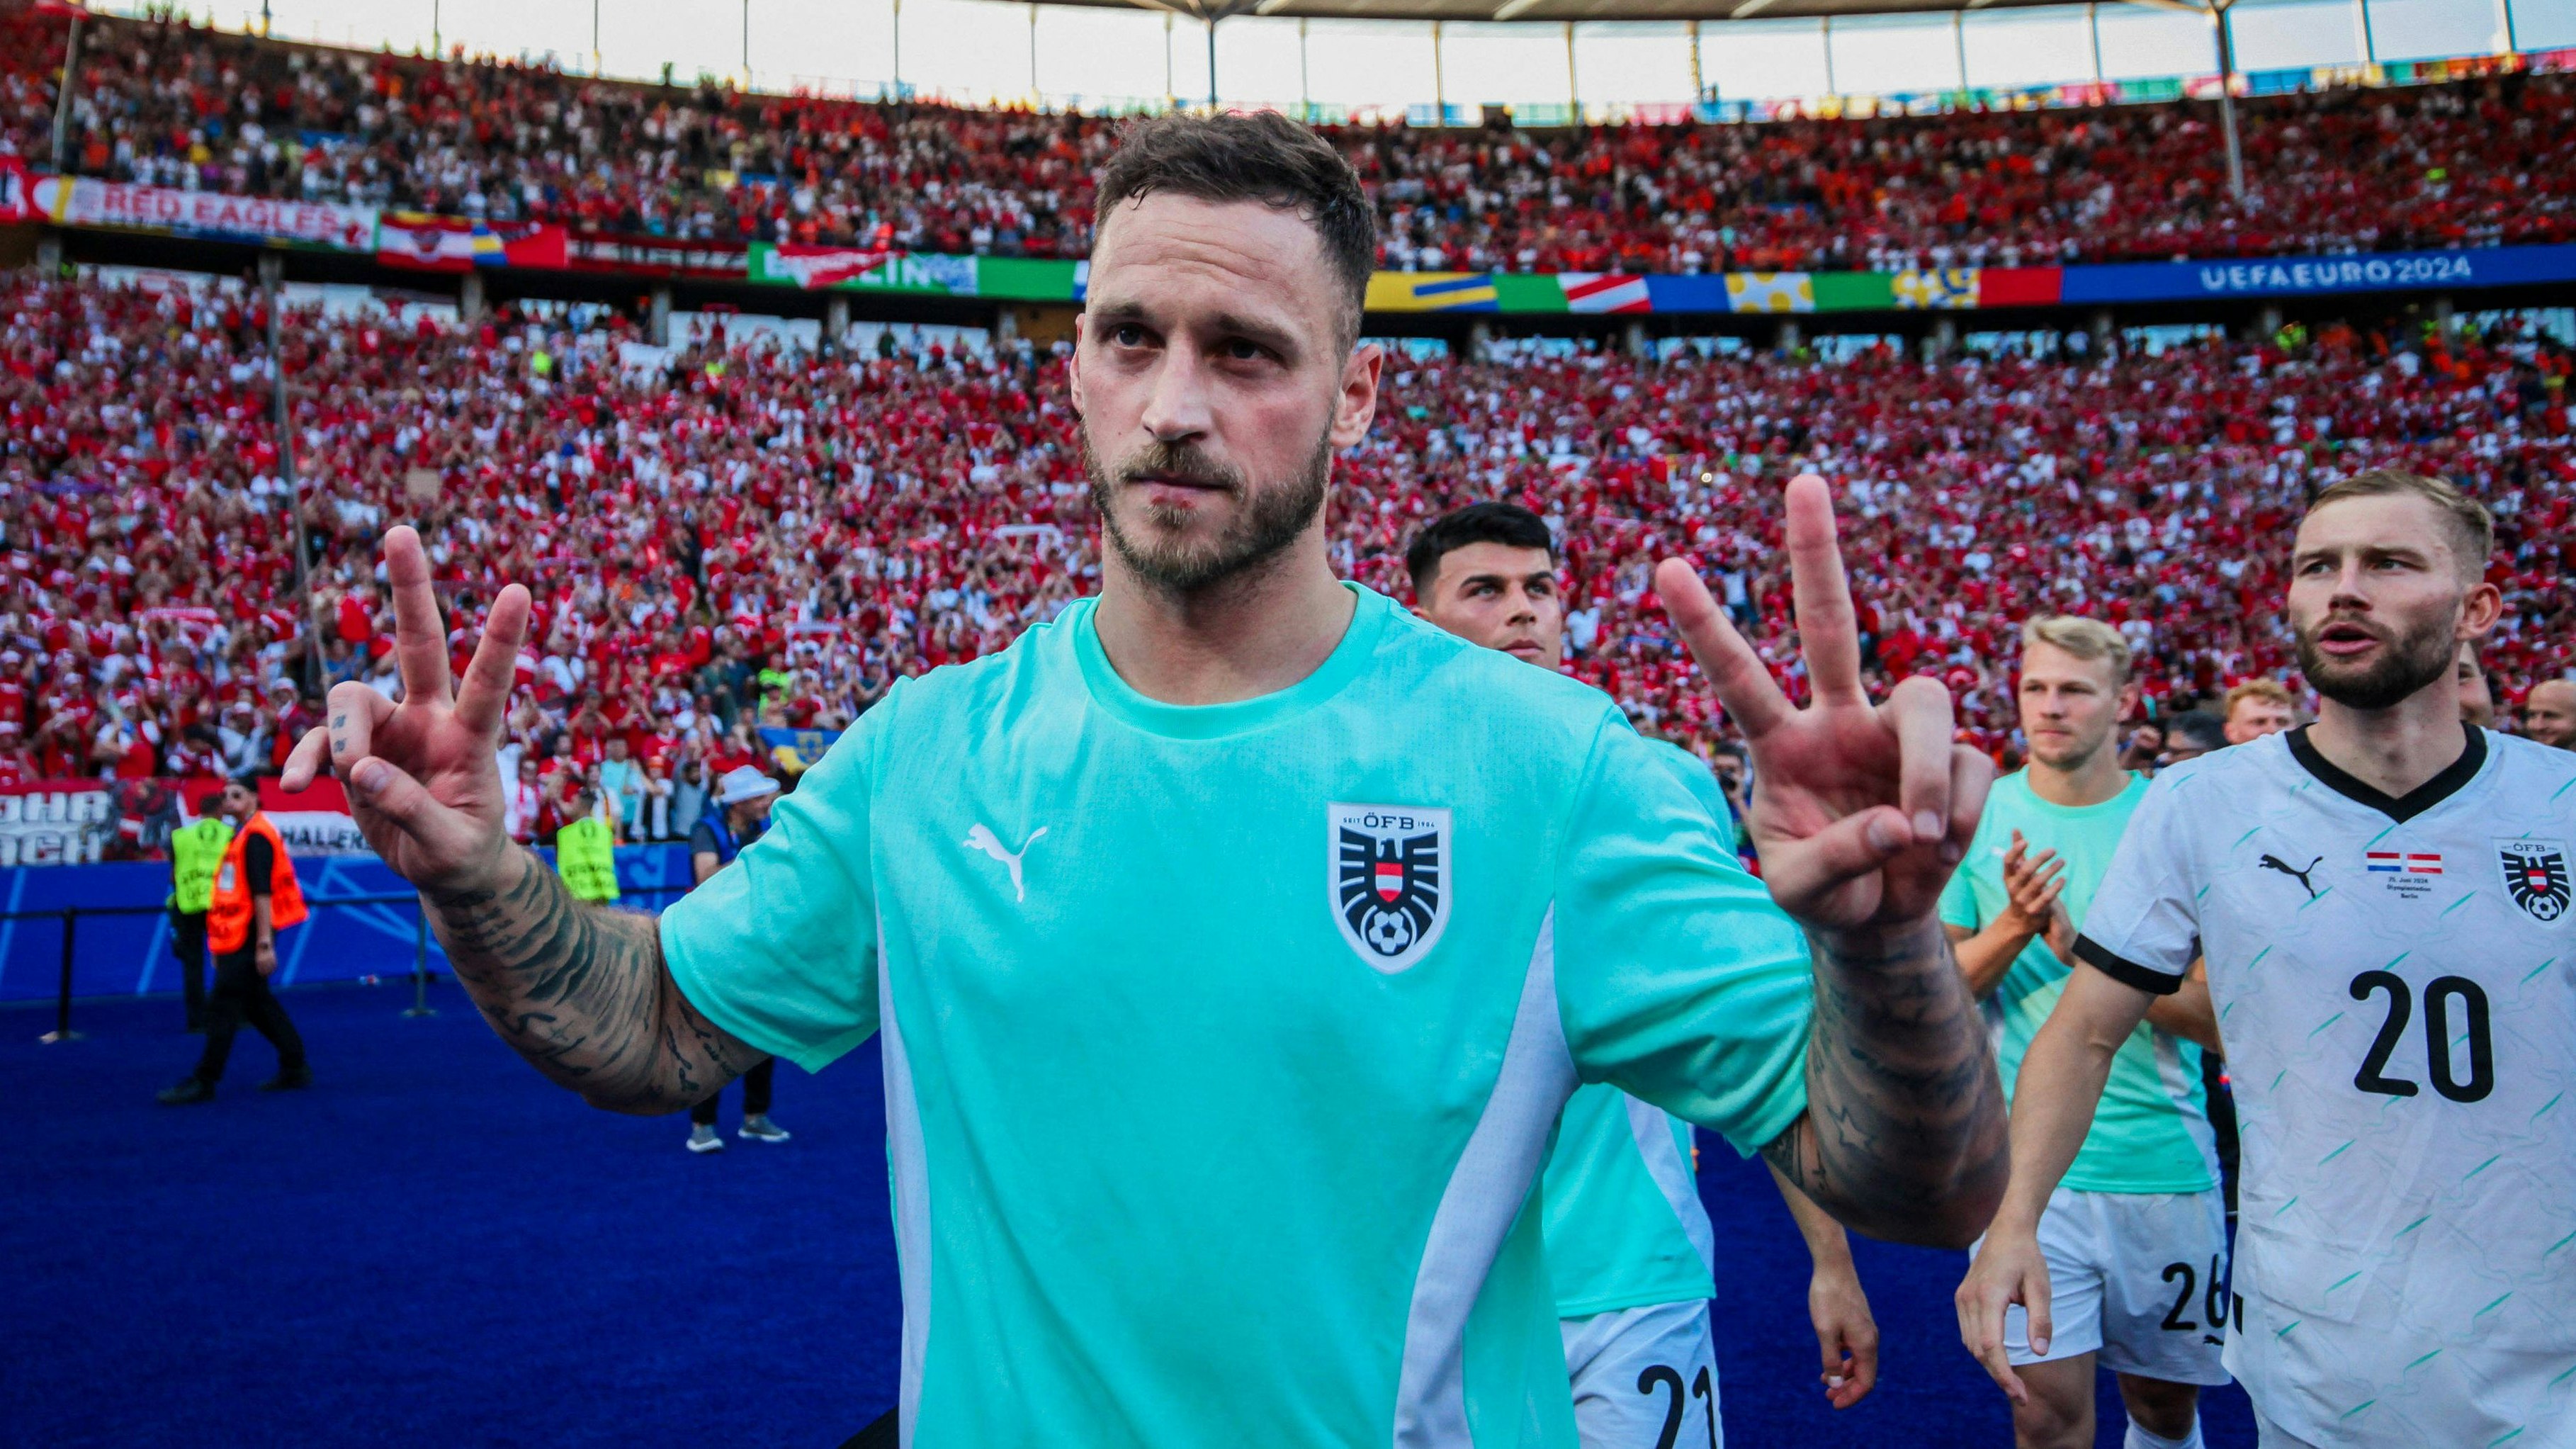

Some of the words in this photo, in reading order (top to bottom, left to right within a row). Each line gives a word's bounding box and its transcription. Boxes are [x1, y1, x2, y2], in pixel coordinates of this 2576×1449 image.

[104, 182, 180, 220] RED
[194, 197, 339, 239] EAGLES
[1364, 812, 1414, 830] ÖFB
[2349, 970, 2494, 1103] 20
[2161, 1253, 2231, 1329] 26
